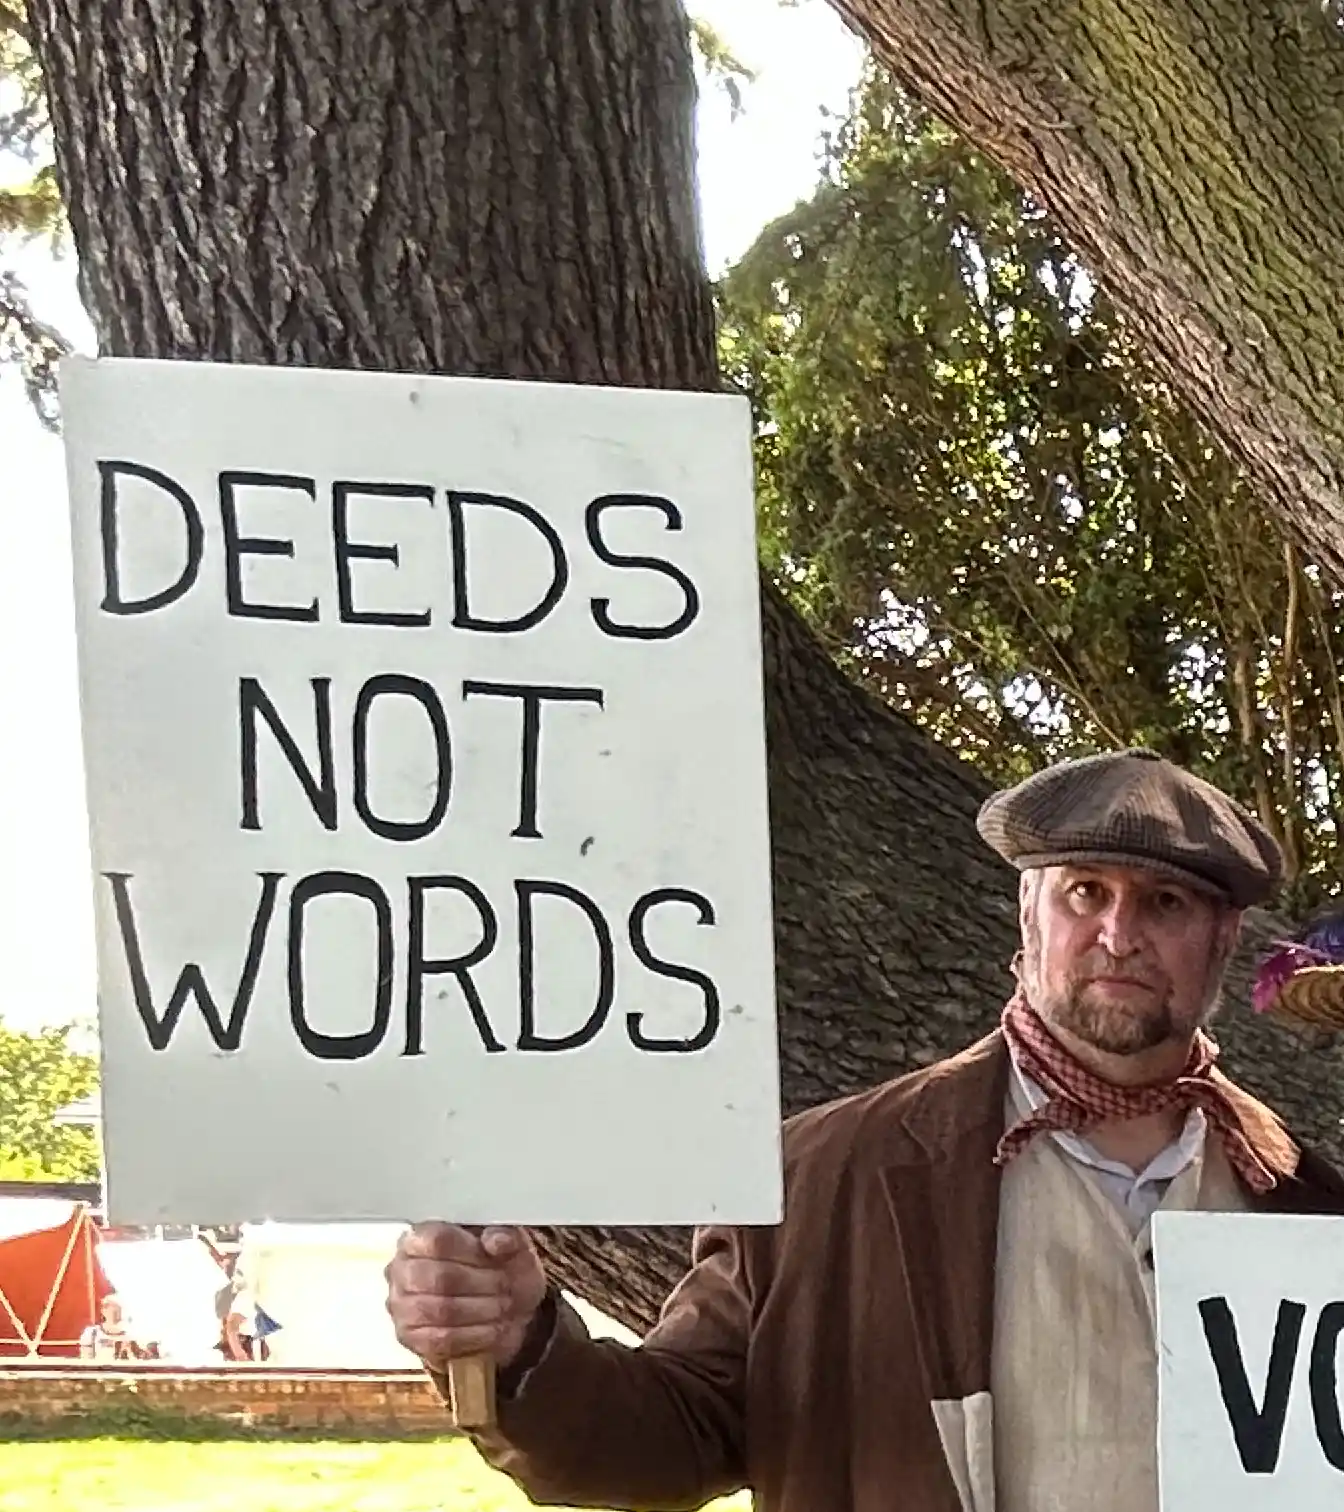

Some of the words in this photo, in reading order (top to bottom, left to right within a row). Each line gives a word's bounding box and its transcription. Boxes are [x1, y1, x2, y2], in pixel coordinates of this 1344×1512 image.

[96, 460, 699, 640] DEEDS
[239, 673, 604, 842] NOT
[103, 870, 720, 1060] WORDS
